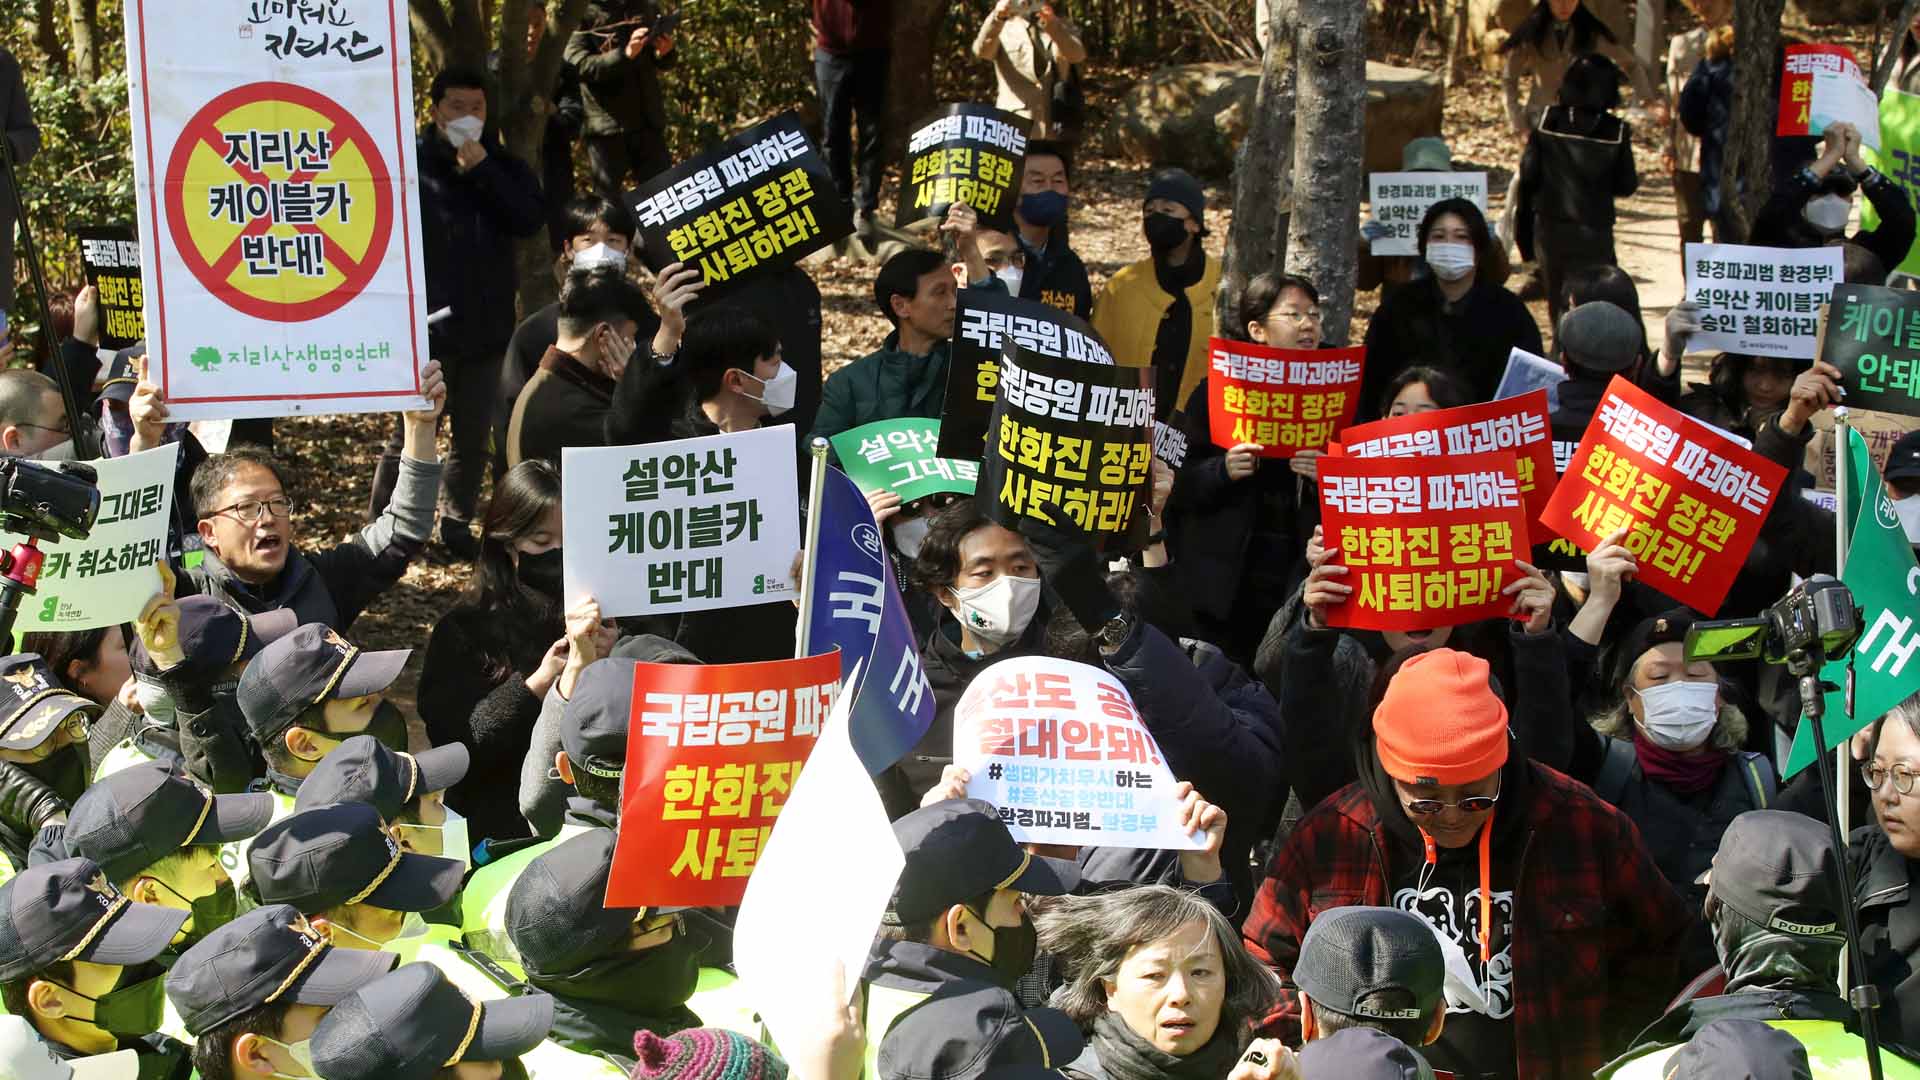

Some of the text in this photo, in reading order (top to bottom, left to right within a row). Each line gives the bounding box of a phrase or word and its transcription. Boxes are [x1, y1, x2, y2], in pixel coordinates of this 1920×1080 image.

[265, 26, 384, 62] 지리산
[224, 131, 331, 171] 지리산
[908, 114, 1027, 157] 국립공원 파괴하는
[635, 130, 809, 228] 국립공원 파괴하는
[911, 147, 1014, 188] 한화진 장관
[209, 183, 351, 223] 케이블카
[666, 167, 815, 262] 한화진 장관
[914, 176, 1002, 216] 사퇴하라!
[1378, 204, 1419, 220] 설악산
[242, 235, 325, 276] 반대!
[699, 205, 821, 286] 사퇴하라!
[97, 274, 128, 306] 한화진
[1696, 260, 1833, 283] 환경파괴범 환경부!
[1695, 288, 1750, 310] 설악산
[1700, 314, 1737, 334] 승인
[228, 342, 391, 372] 지리산생명연대
[1212, 349, 1361, 386] 국립공원 파괴하는
[1000, 353, 1083, 423] 국립공원
[1223, 385, 1346, 420] 한화진 장관
[998, 413, 1151, 486] 한화진 장관
[1231, 417, 1335, 448] 사퇴하라!
[1443, 411, 1546, 457] 파괴하는
[622, 447, 737, 503] 설악산
[1598, 393, 1681, 466] 국립공원
[1671, 439, 1771, 516] 파괴하는
[97, 484, 164, 525] 그대로!
[1322, 475, 1422, 515] 국립공원
[1427, 471, 1520, 511] 파괴하는
[1581, 443, 1672, 520] 한화진
[1667, 493, 1738, 553] 장관
[608, 499, 764, 554] 케이블카
[1340, 525, 1440, 567] 한화진
[1449, 520, 1513, 564] 장관
[1571, 490, 1706, 584] 사퇴하라!
[76, 538, 161, 578] 취소하라!
[647, 557, 723, 605] 반대
[1358, 567, 1503, 612] 사퇴하라!
[641, 688, 787, 747] 국립공원
[979, 718, 1161, 766] 절대안돼!
[661, 760, 803, 821] 한화진
[1778, 921, 1835, 933] POLICE
[1360, 1006, 1417, 1018] POLICE
